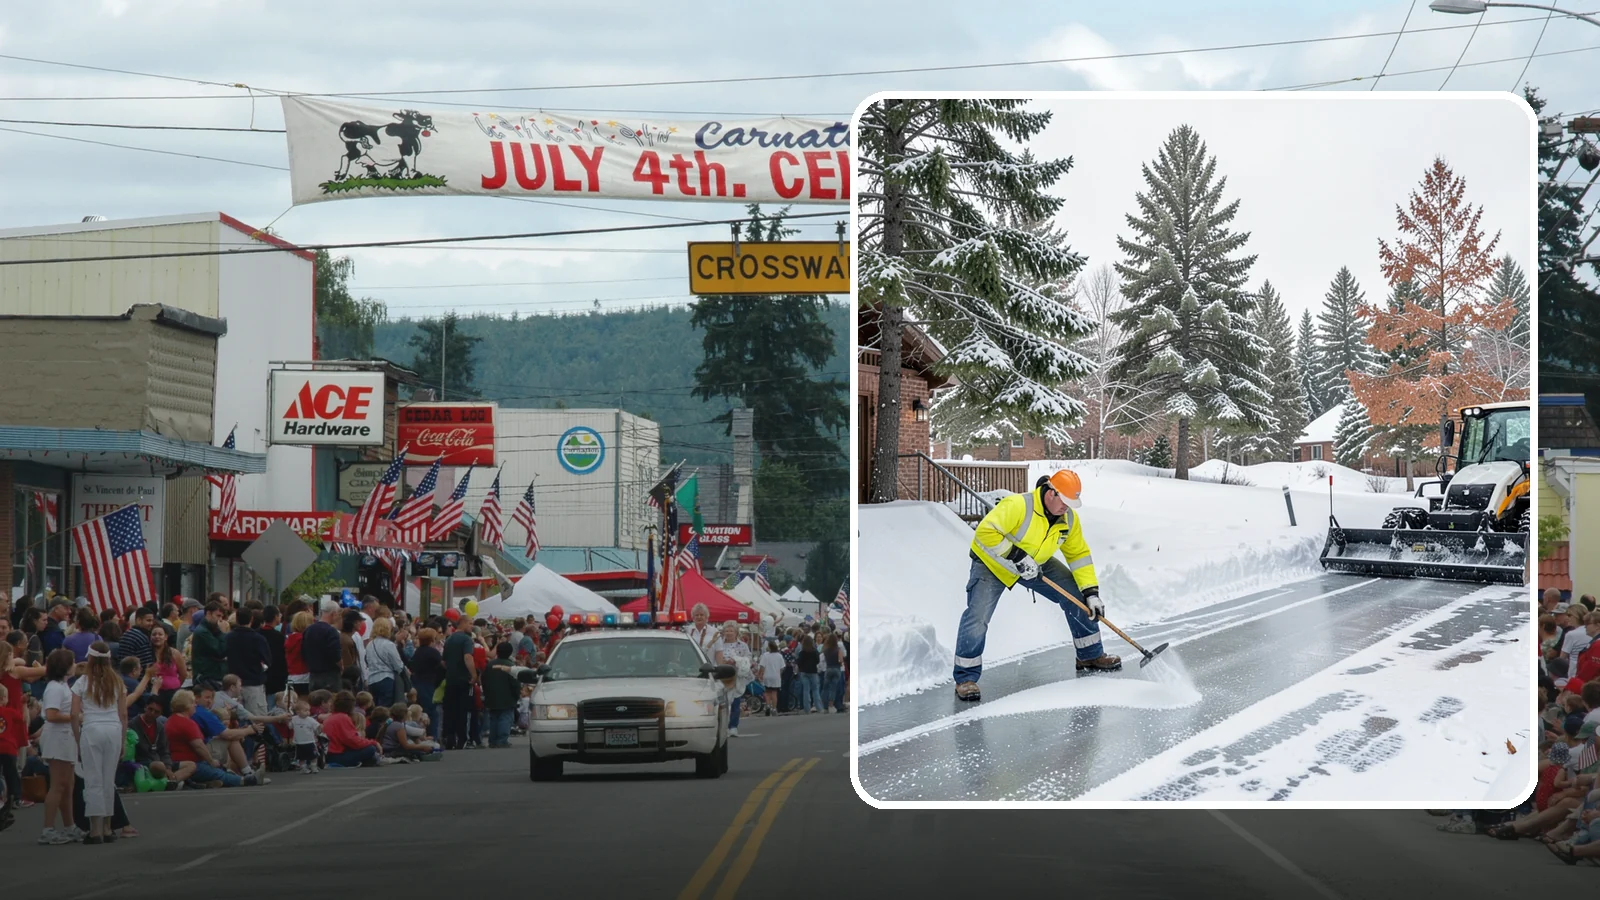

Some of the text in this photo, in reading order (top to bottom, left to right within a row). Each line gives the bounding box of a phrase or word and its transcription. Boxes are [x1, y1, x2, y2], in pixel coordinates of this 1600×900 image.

[481, 141, 604, 192] JULY
[632, 150, 746, 197] 4th.
[697, 254, 850, 280] CROSSWA
[283, 380, 374, 420] ACE
[405, 409, 485, 421] CEDAR LOG
[283, 421, 371, 436] Hardware
[416, 428, 477, 446] Coca-Cola
[83, 484, 155, 495] St. Vincent de Paul
[688, 526, 742, 535] CRNATION
[699, 535, 731, 543] GLASS
